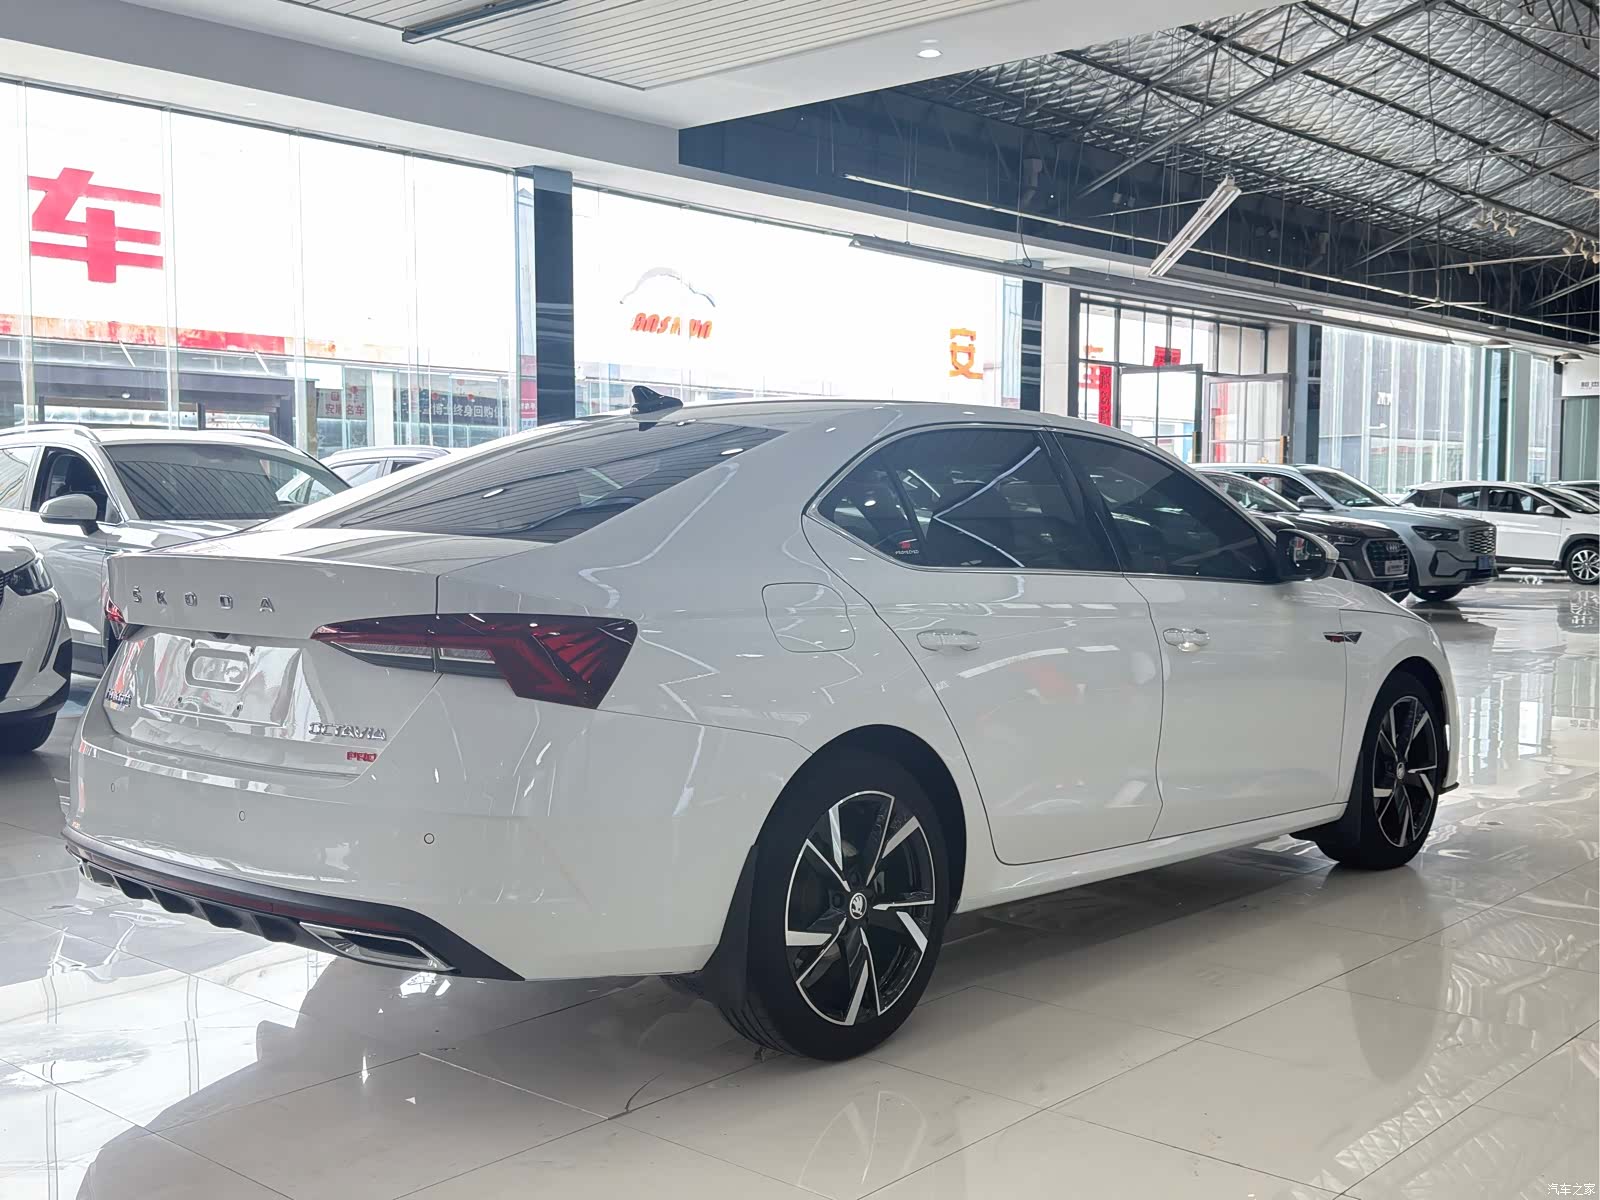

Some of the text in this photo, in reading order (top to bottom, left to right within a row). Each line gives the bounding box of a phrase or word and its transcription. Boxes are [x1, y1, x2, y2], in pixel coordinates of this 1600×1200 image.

[27, 167, 163, 283] 车
[949, 328, 983, 380] 安
[308, 722, 387, 741] OCTAVIA
[346, 751, 377, 762] PRO
